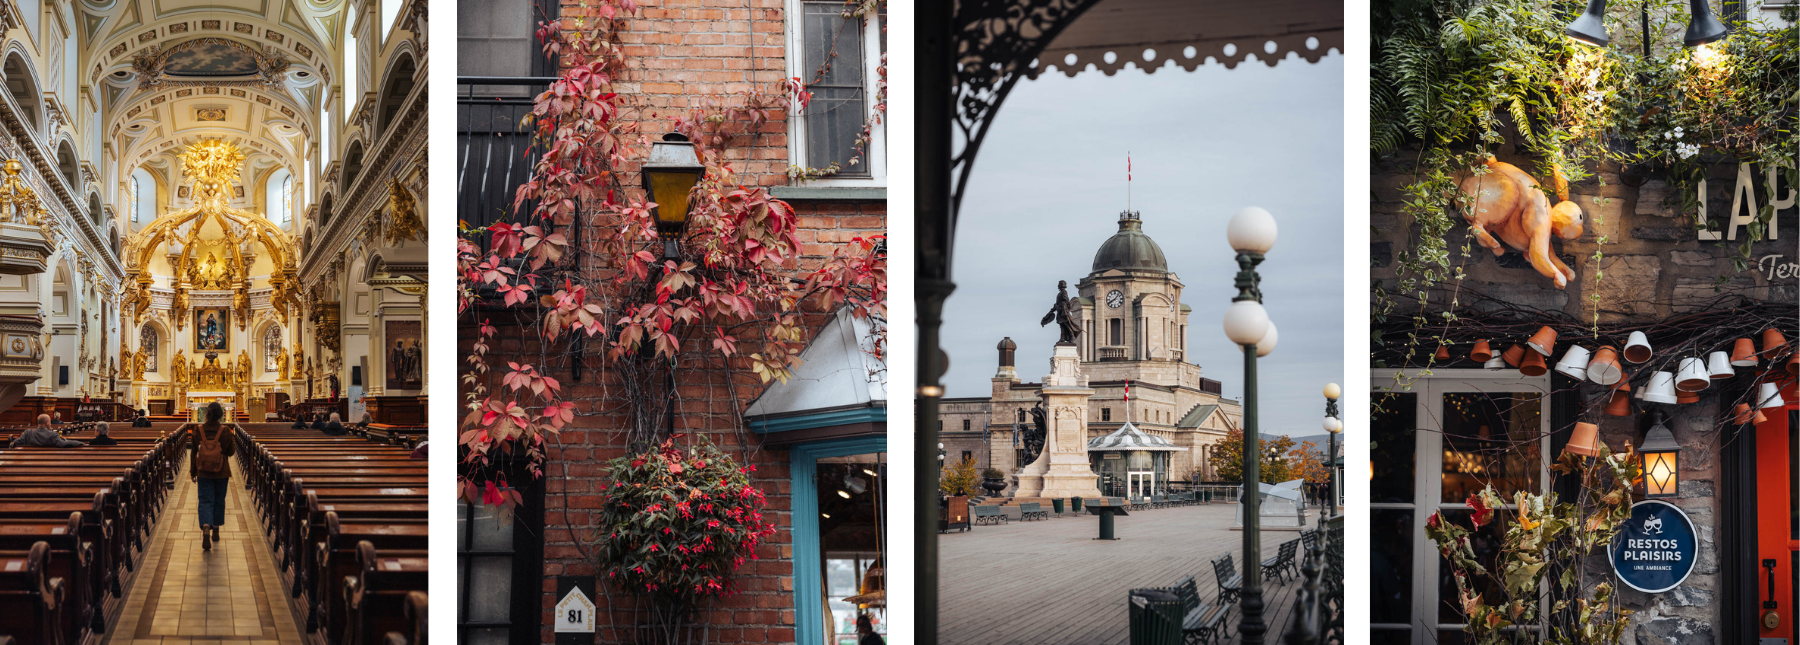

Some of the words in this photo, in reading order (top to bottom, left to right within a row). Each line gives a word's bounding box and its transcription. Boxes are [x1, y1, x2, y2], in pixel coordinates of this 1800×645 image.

[1698, 160, 1798, 240] LAP
[1628, 539, 1678, 549] RESTOS
[1624, 551, 1682, 561] PLAISIRS
[560, 592, 576, 609] PETIT
[576, 592, 594, 631] CHAMPLAIN
[568, 609, 583, 623] 81
